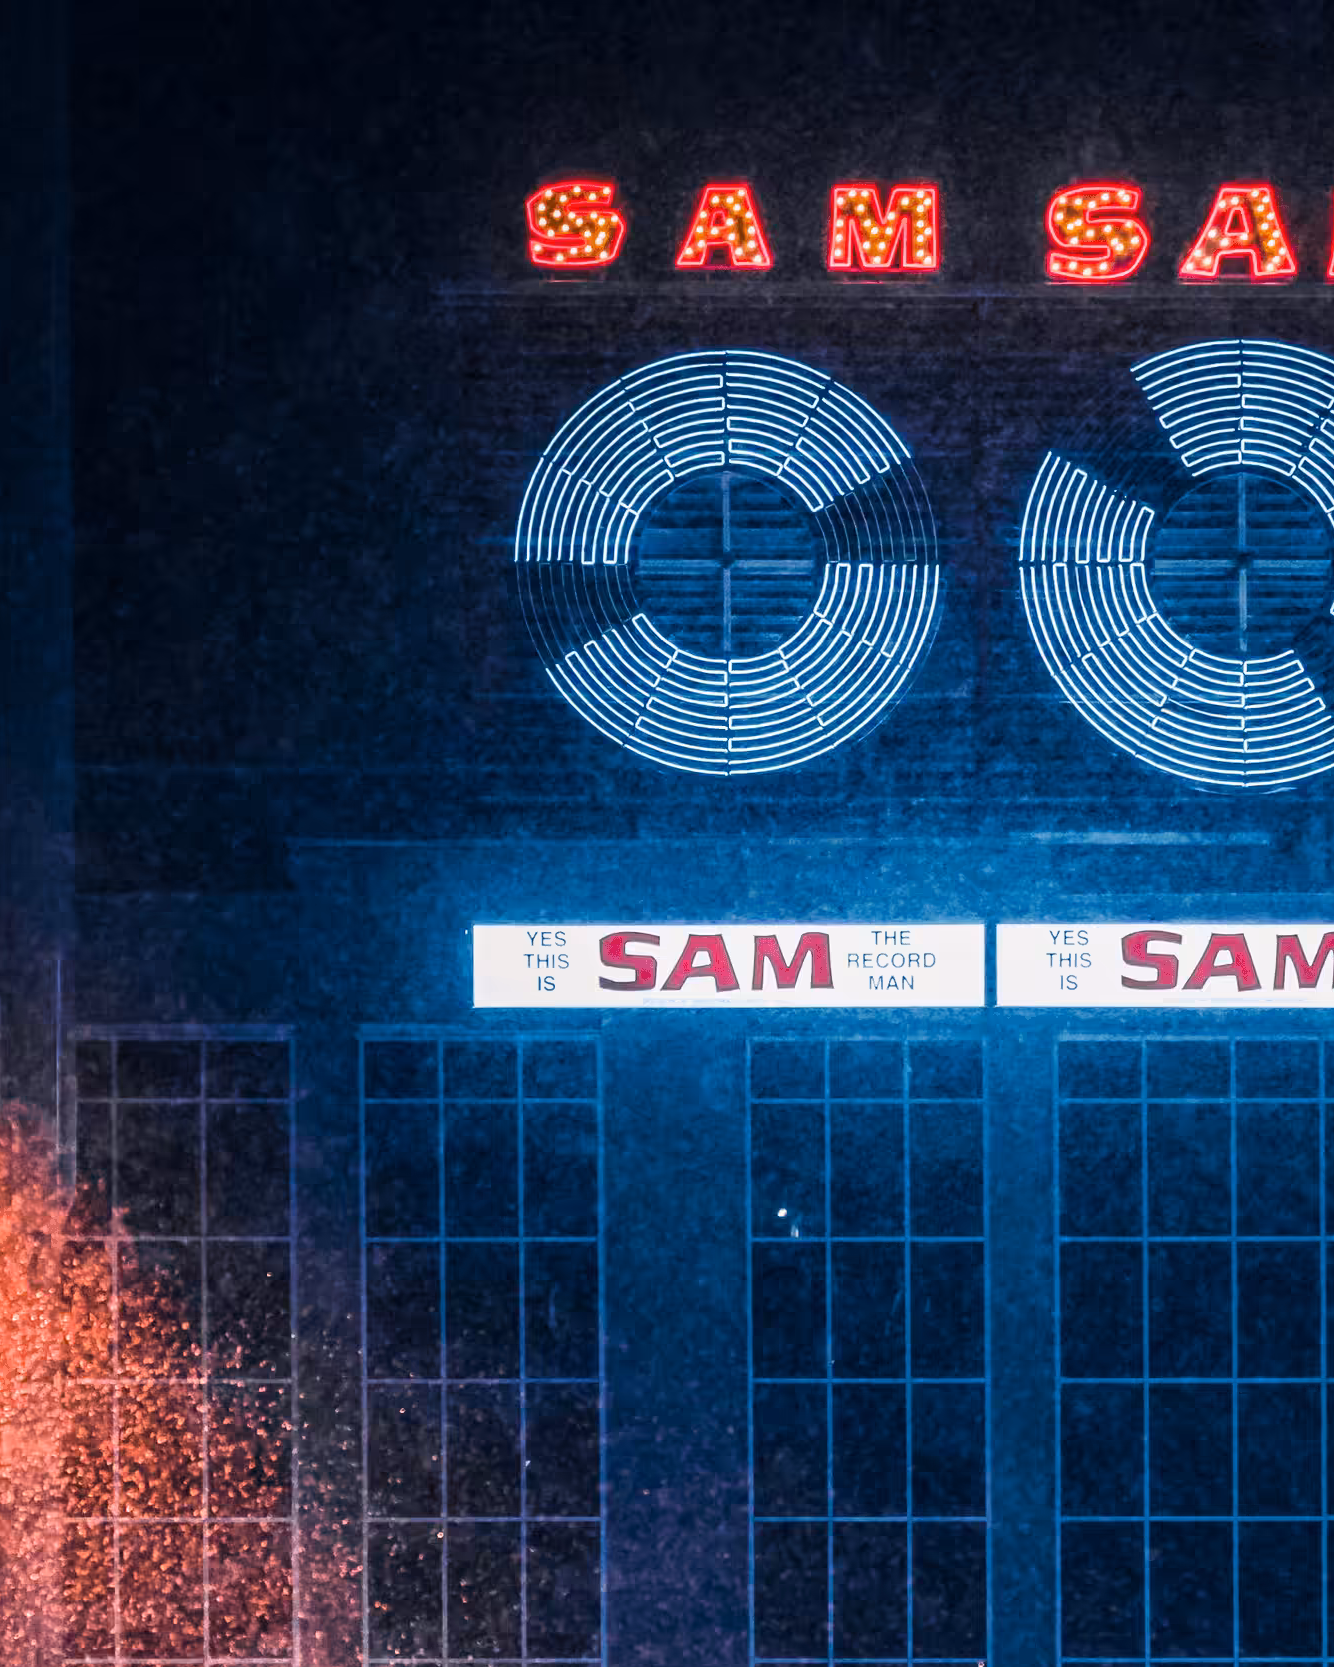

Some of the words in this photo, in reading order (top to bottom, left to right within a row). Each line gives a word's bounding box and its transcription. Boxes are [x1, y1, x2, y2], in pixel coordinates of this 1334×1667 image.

[525, 180, 940, 272] SAM
[526, 930, 568, 948] YES
[870, 930, 912, 947] THE
[1048, 930, 1090, 947] YES
[523, 952, 570, 970] THIS
[598, 931, 835, 992] SAM
[846, 951, 937, 969] RECORD
[1045, 952, 1093, 969] THIS
[537, 975, 557, 992] IS
[868, 974, 916, 991] MAN
[1060, 974, 1079, 991] IS
